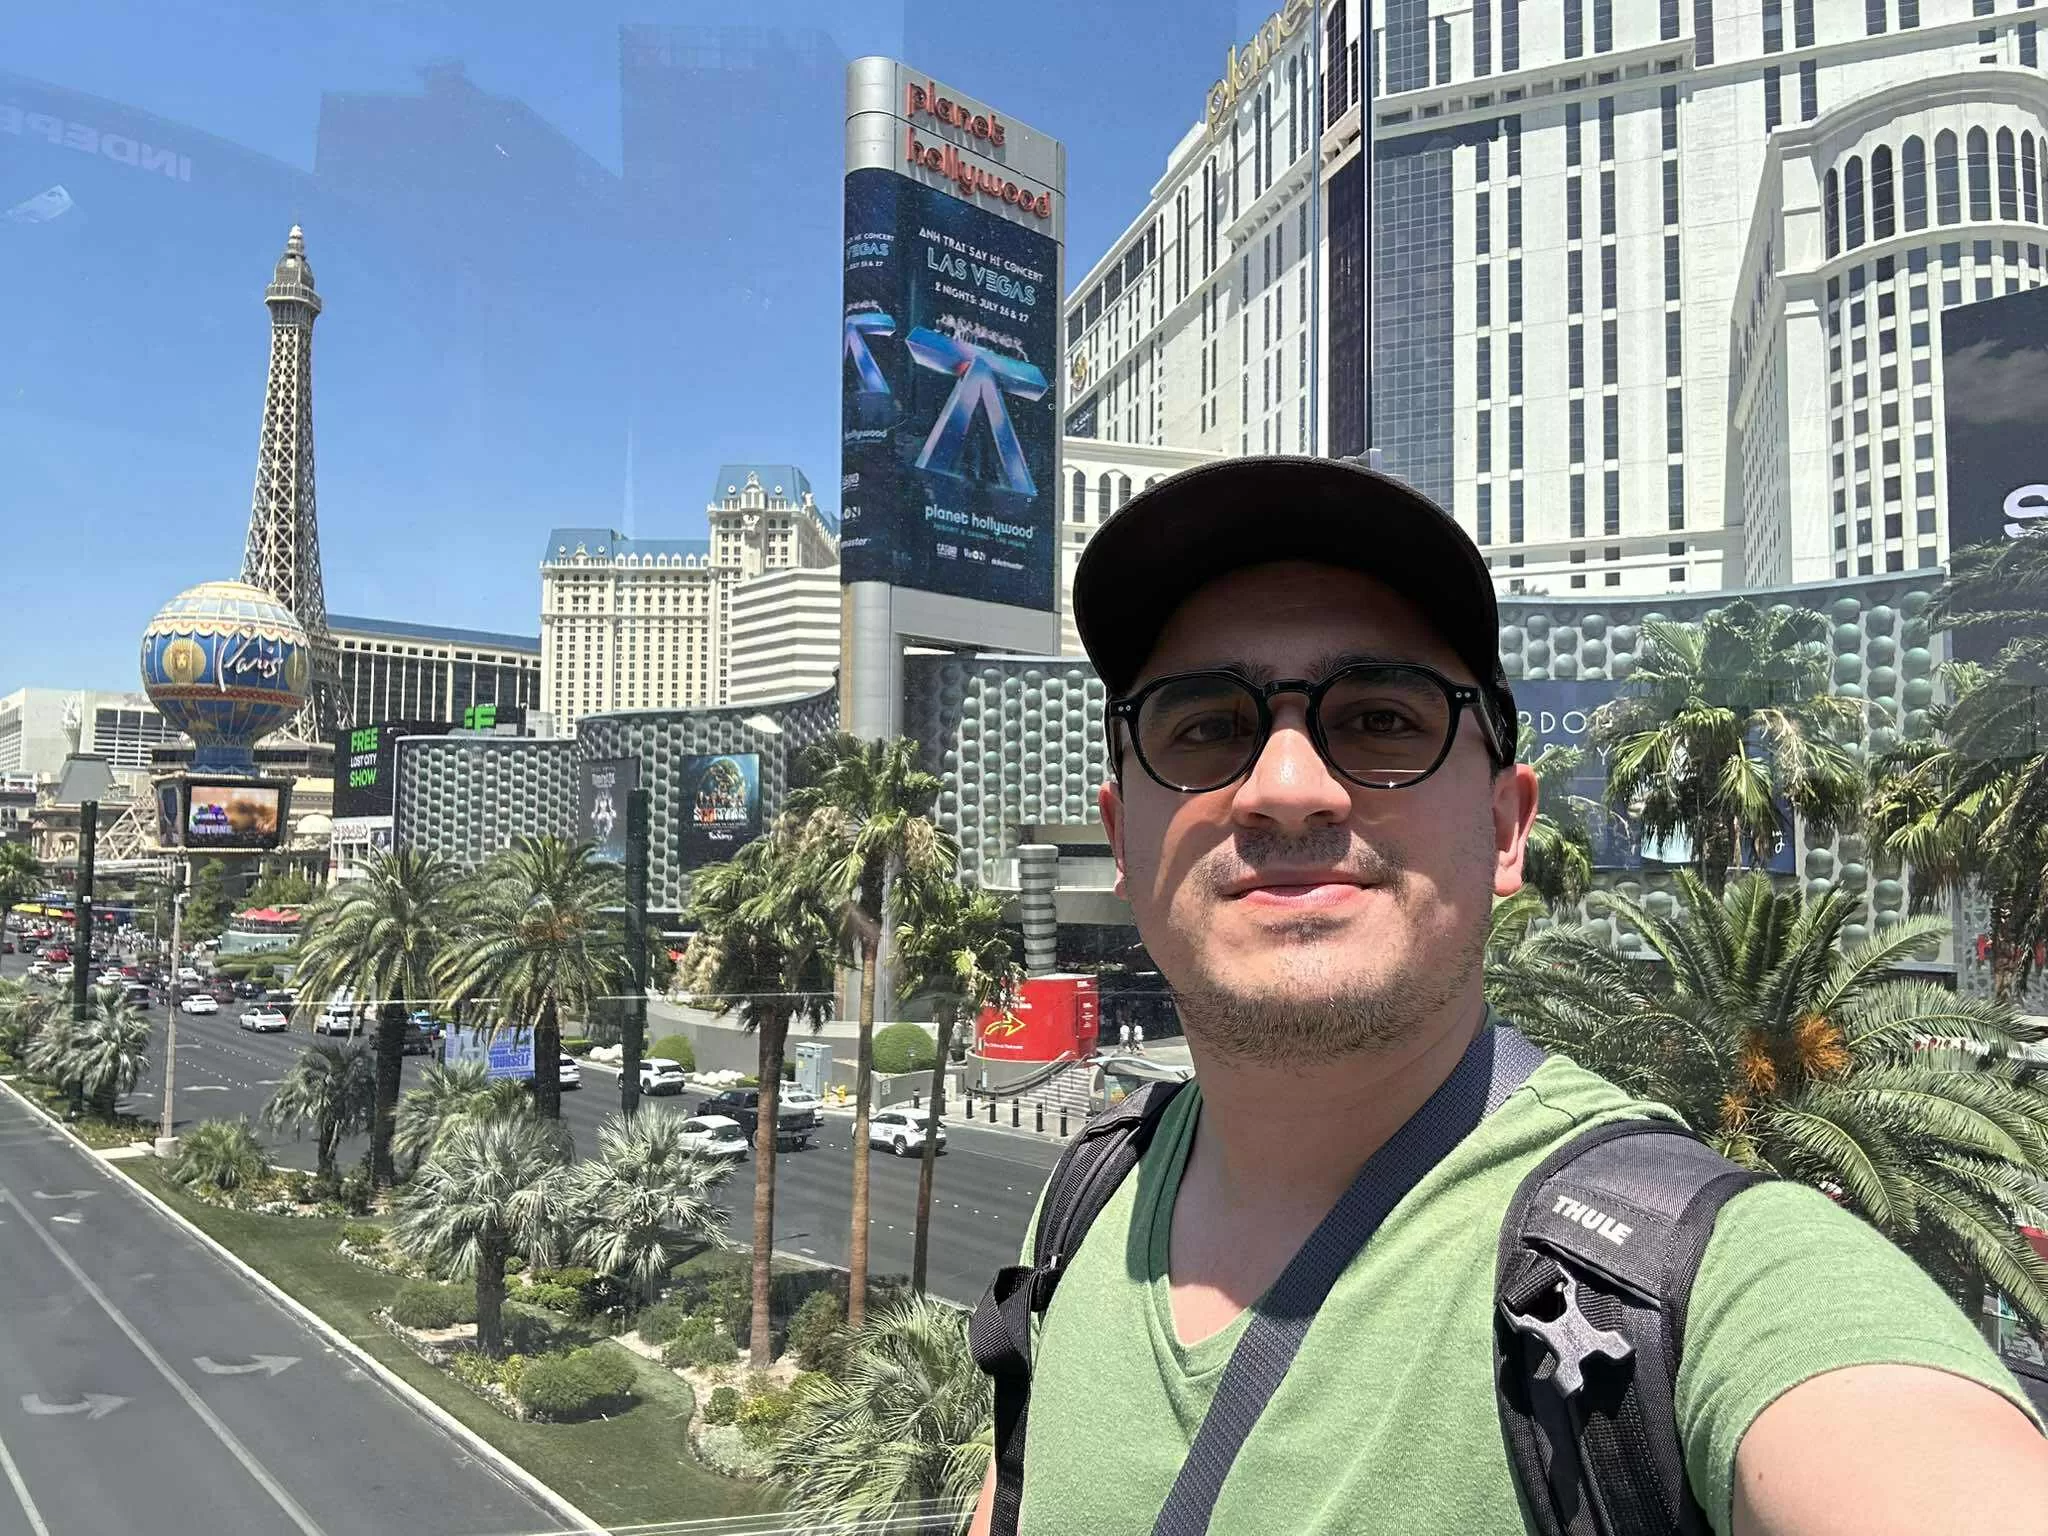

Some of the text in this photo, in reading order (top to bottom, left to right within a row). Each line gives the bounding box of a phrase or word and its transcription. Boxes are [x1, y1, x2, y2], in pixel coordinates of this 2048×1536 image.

[1206, 0, 1313, 145] plane
[906, 80, 1006, 147] planet
[907, 127, 1051, 218] hollywood
[849, 242, 889, 258] EGAS
[919, 226, 941, 244] ANH
[943, 235, 966, 253] TRAI
[1003, 260, 1043, 283] CONCERT
[927, 246, 1037, 307] LAS VEGAS
[979, 297, 999, 312] JULY
[1018, 312, 1029, 323] 27
[925, 503, 969, 525] planet
[972, 512, 1033, 539] hollywood
[216, 624, 284, 693] Paris
[350, 755, 364, 768] LOST
[351, 727, 378, 753] FREE
[350, 767, 377, 788] SHOW
[1552, 1195, 1633, 1247] THULE
